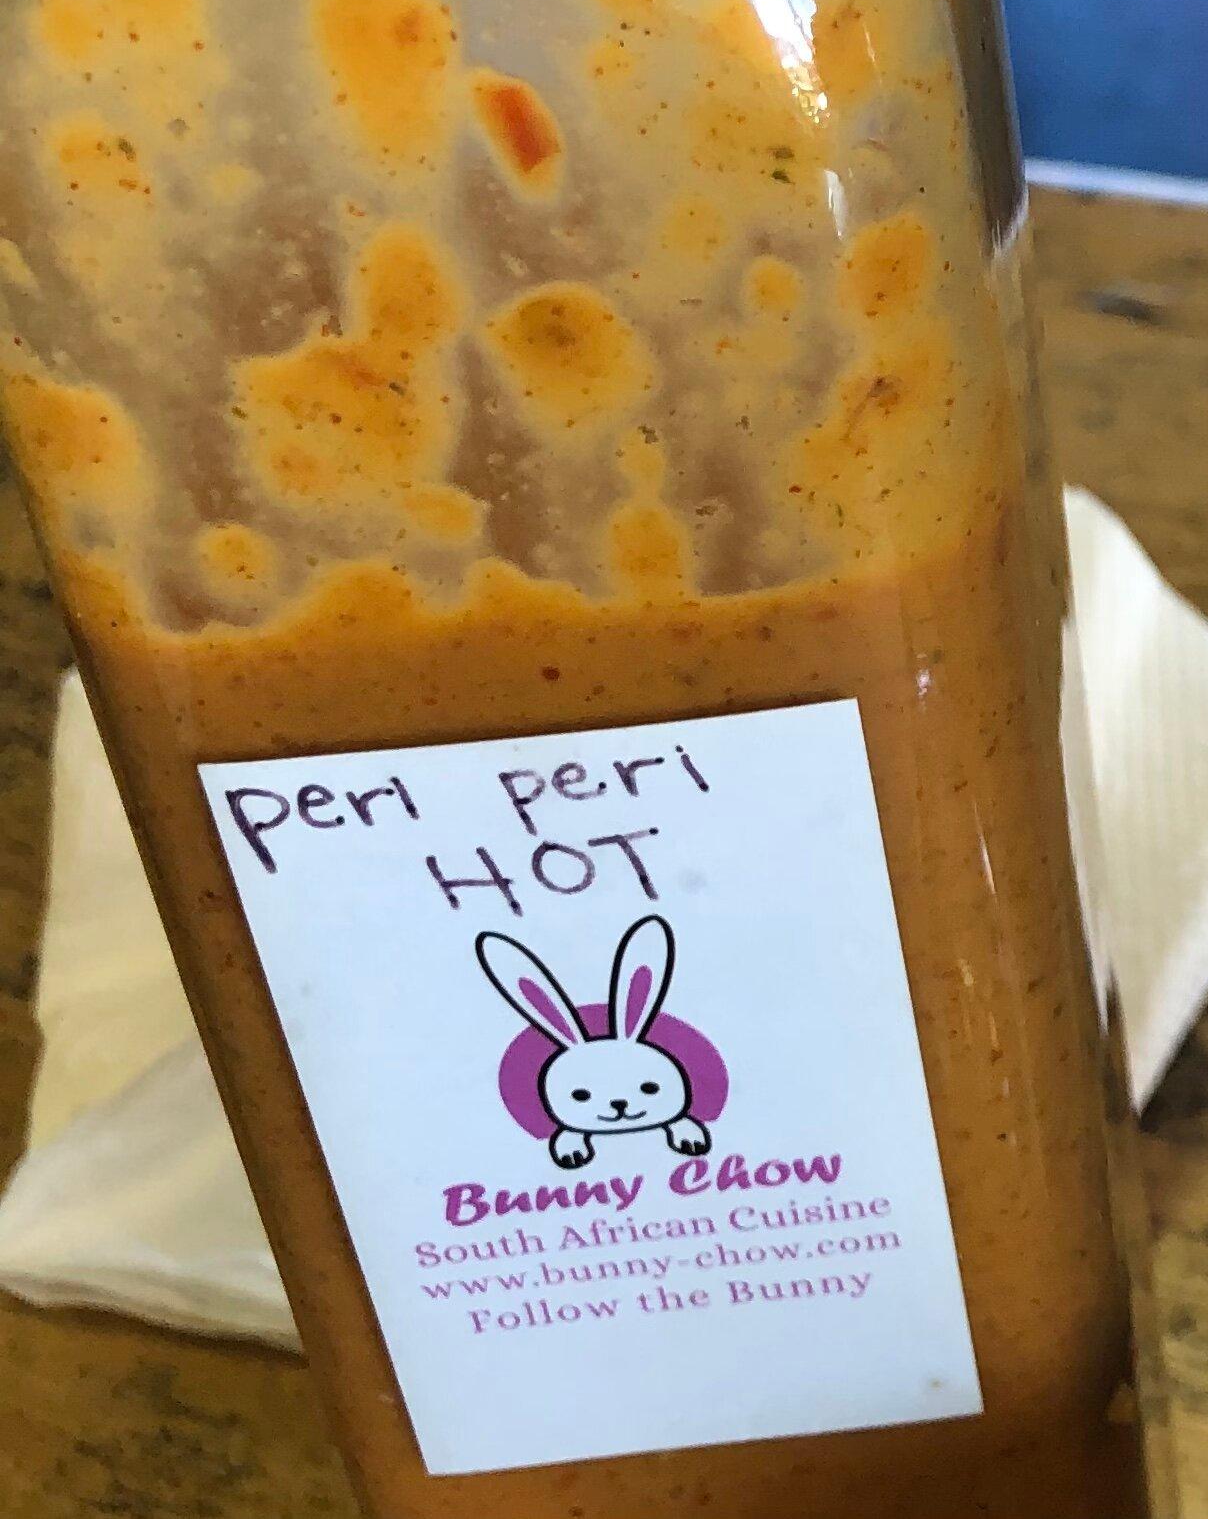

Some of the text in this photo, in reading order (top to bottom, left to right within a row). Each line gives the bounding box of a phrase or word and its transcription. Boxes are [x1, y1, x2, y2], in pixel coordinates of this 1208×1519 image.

[426, 827, 659, 916] HOT
[443, 1152, 842, 1227] Bunny Chow
[414, 1193, 892, 1269] South African Cuisine
[420, 1228, 903, 1300] www.bunny-chow.com
[470, 1269, 874, 1334] Follow the Bunny
